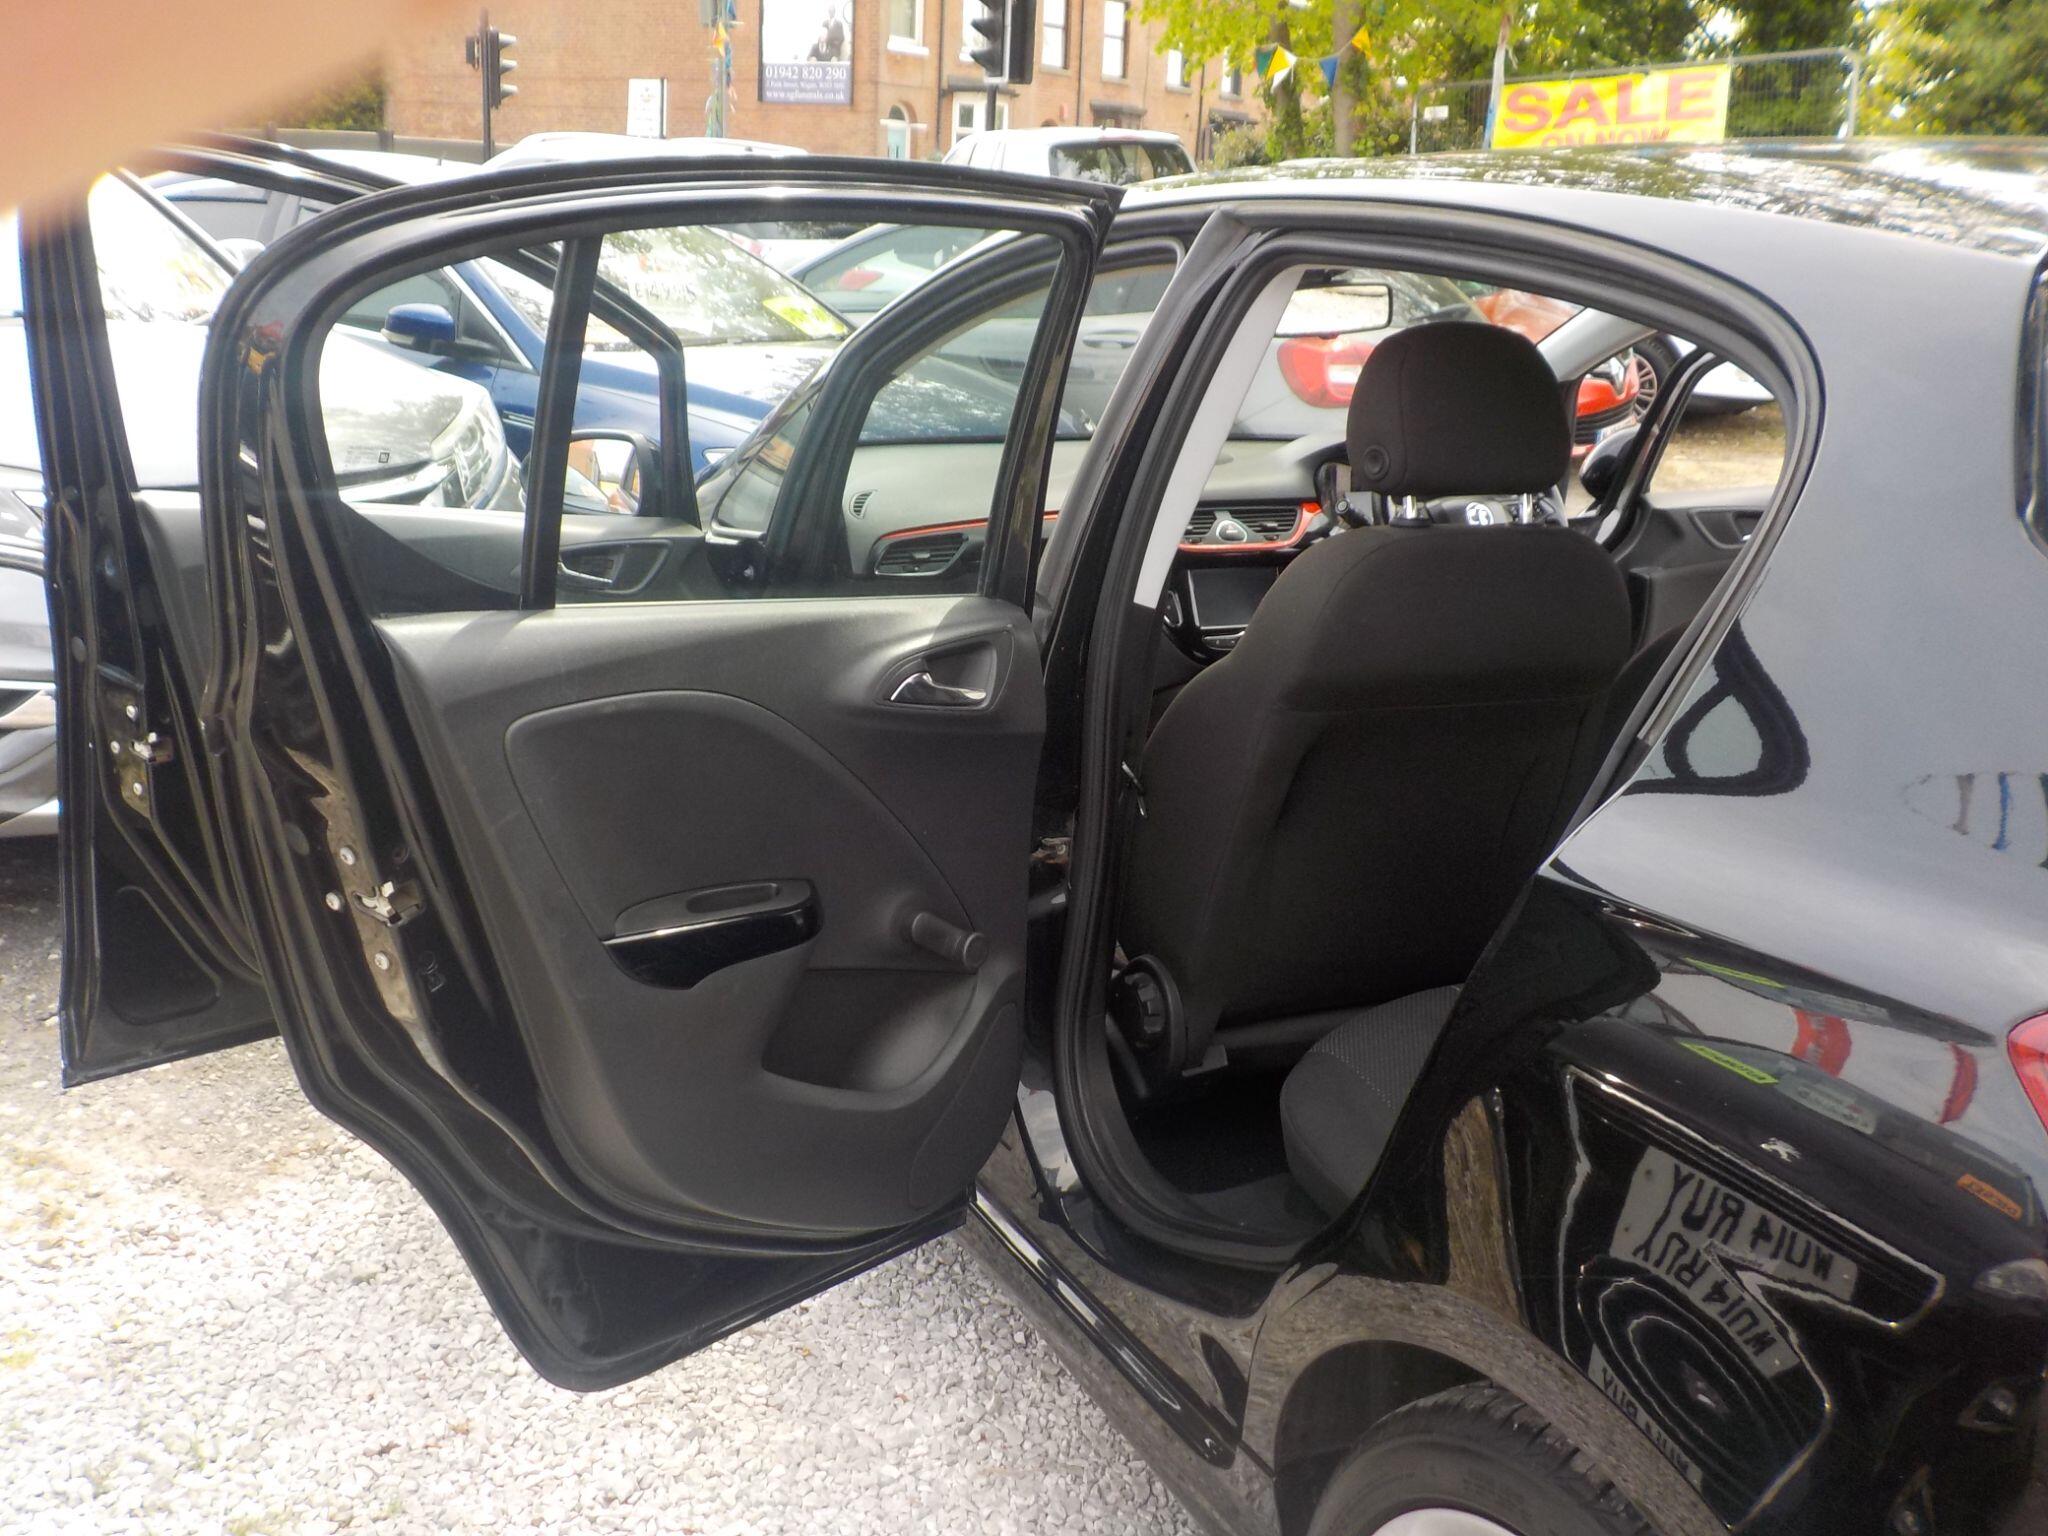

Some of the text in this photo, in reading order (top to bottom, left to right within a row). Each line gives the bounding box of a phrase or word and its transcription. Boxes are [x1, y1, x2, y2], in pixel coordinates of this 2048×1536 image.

[765, 66, 847, 80] 01942 820 290
[1503, 73, 1716, 133] SALE
[1595, 127, 1669, 147] NOW
